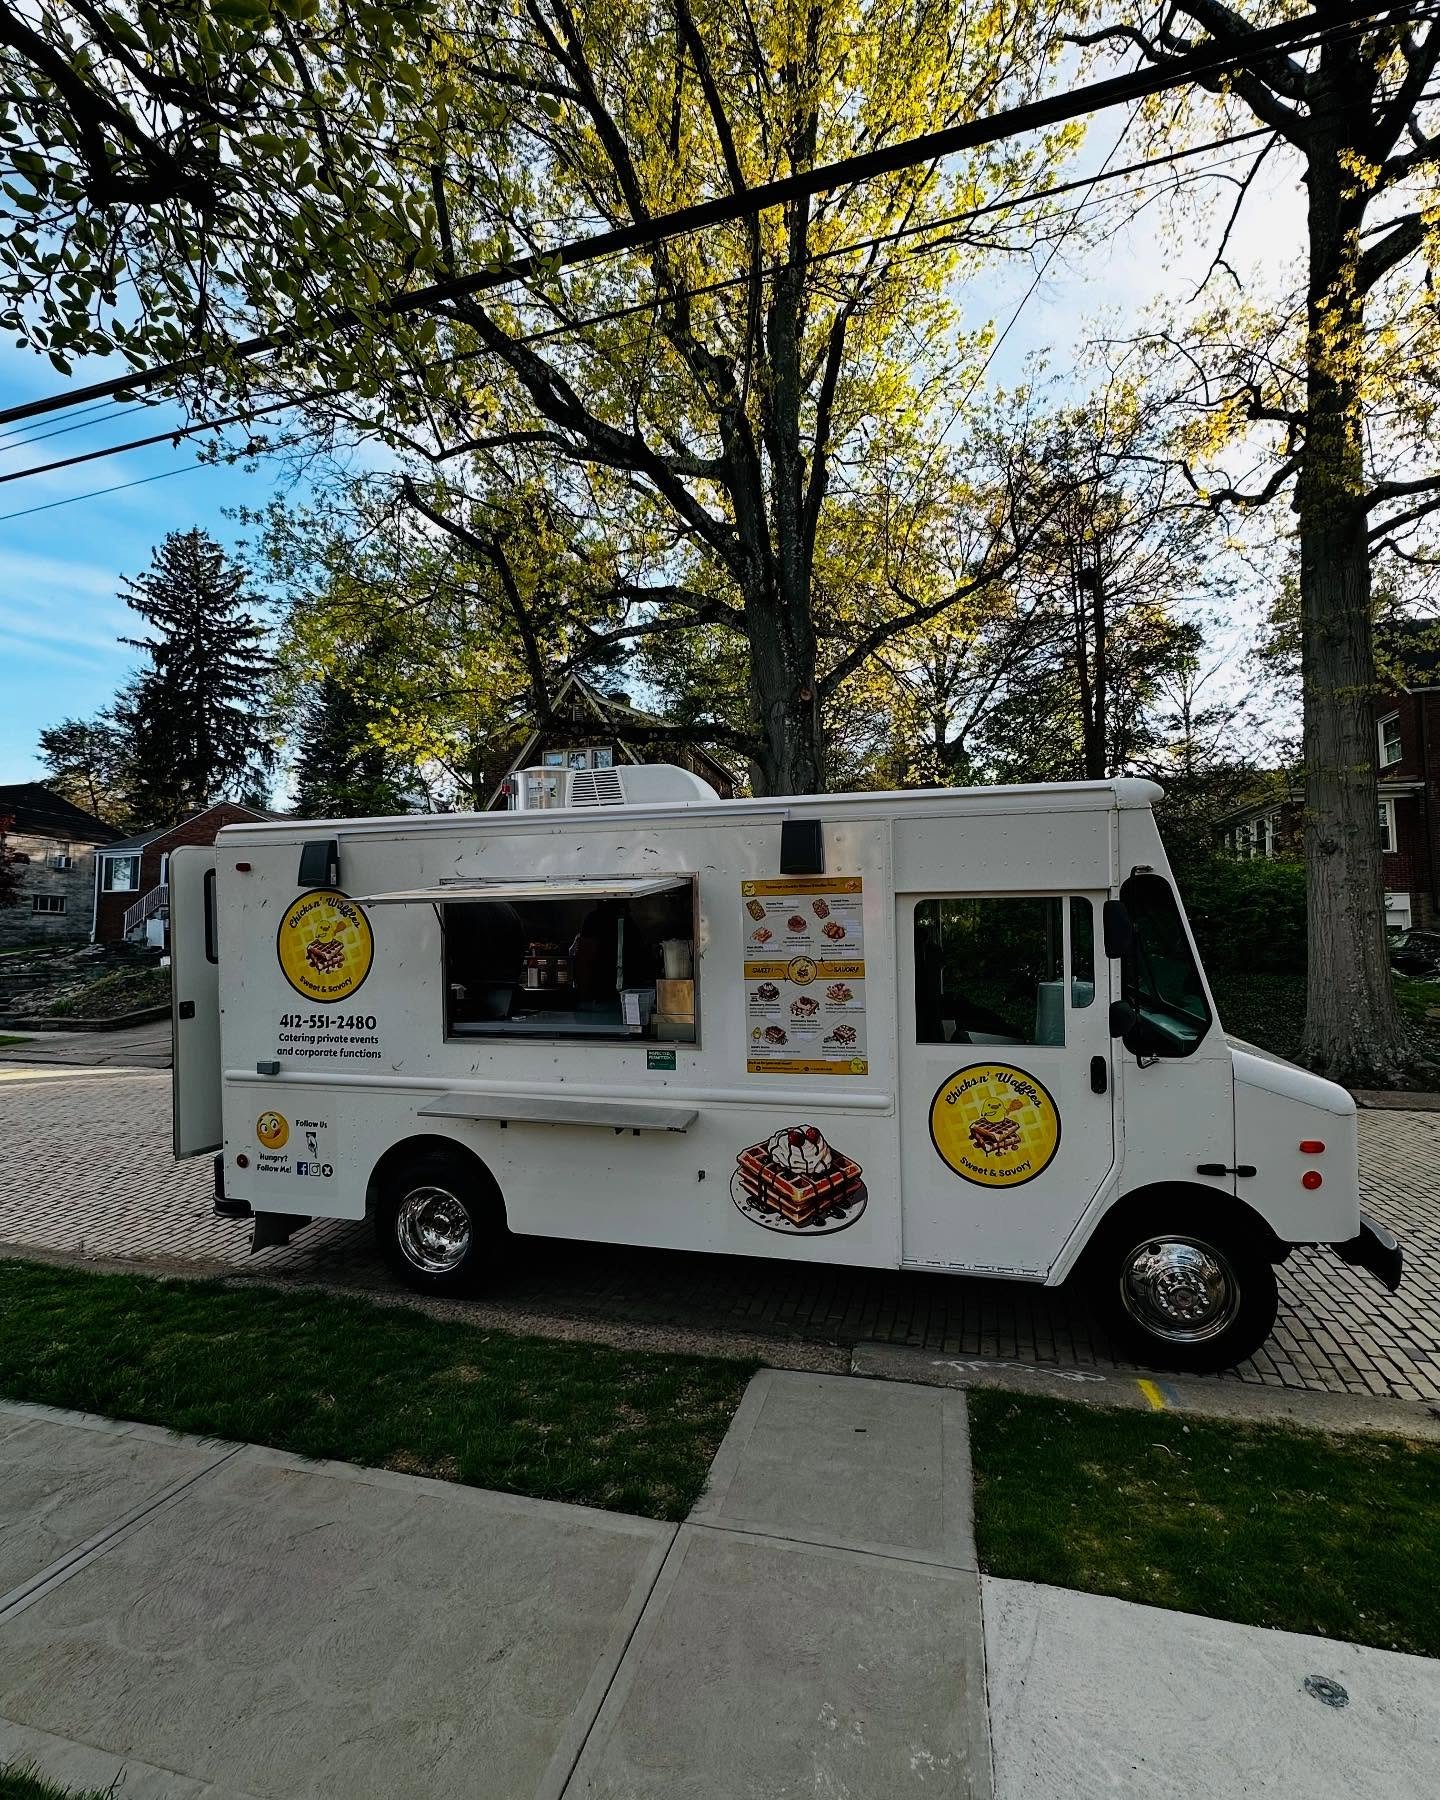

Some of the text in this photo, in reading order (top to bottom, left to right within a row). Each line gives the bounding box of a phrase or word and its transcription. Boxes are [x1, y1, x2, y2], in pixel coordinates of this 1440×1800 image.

[326, 897, 361, 929] Waffles
[300, 976, 352, 993] Sweet & Savory
[279, 1014, 377, 1030] 412-551-2480
[279, 1033, 379, 1044] Catering private events
[277, 1047, 381, 1058] and corporate functions
[945, 1078, 979, 1104] Chicks
[995, 1072, 1042, 1108] Waffles
[295, 1120, 318, 1128] Follow
[259, 1153, 288, 1162] Hungry?
[257, 1164, 292, 1173] Follow Me!
[960, 1157, 1031, 1177] Sweet & Savory
